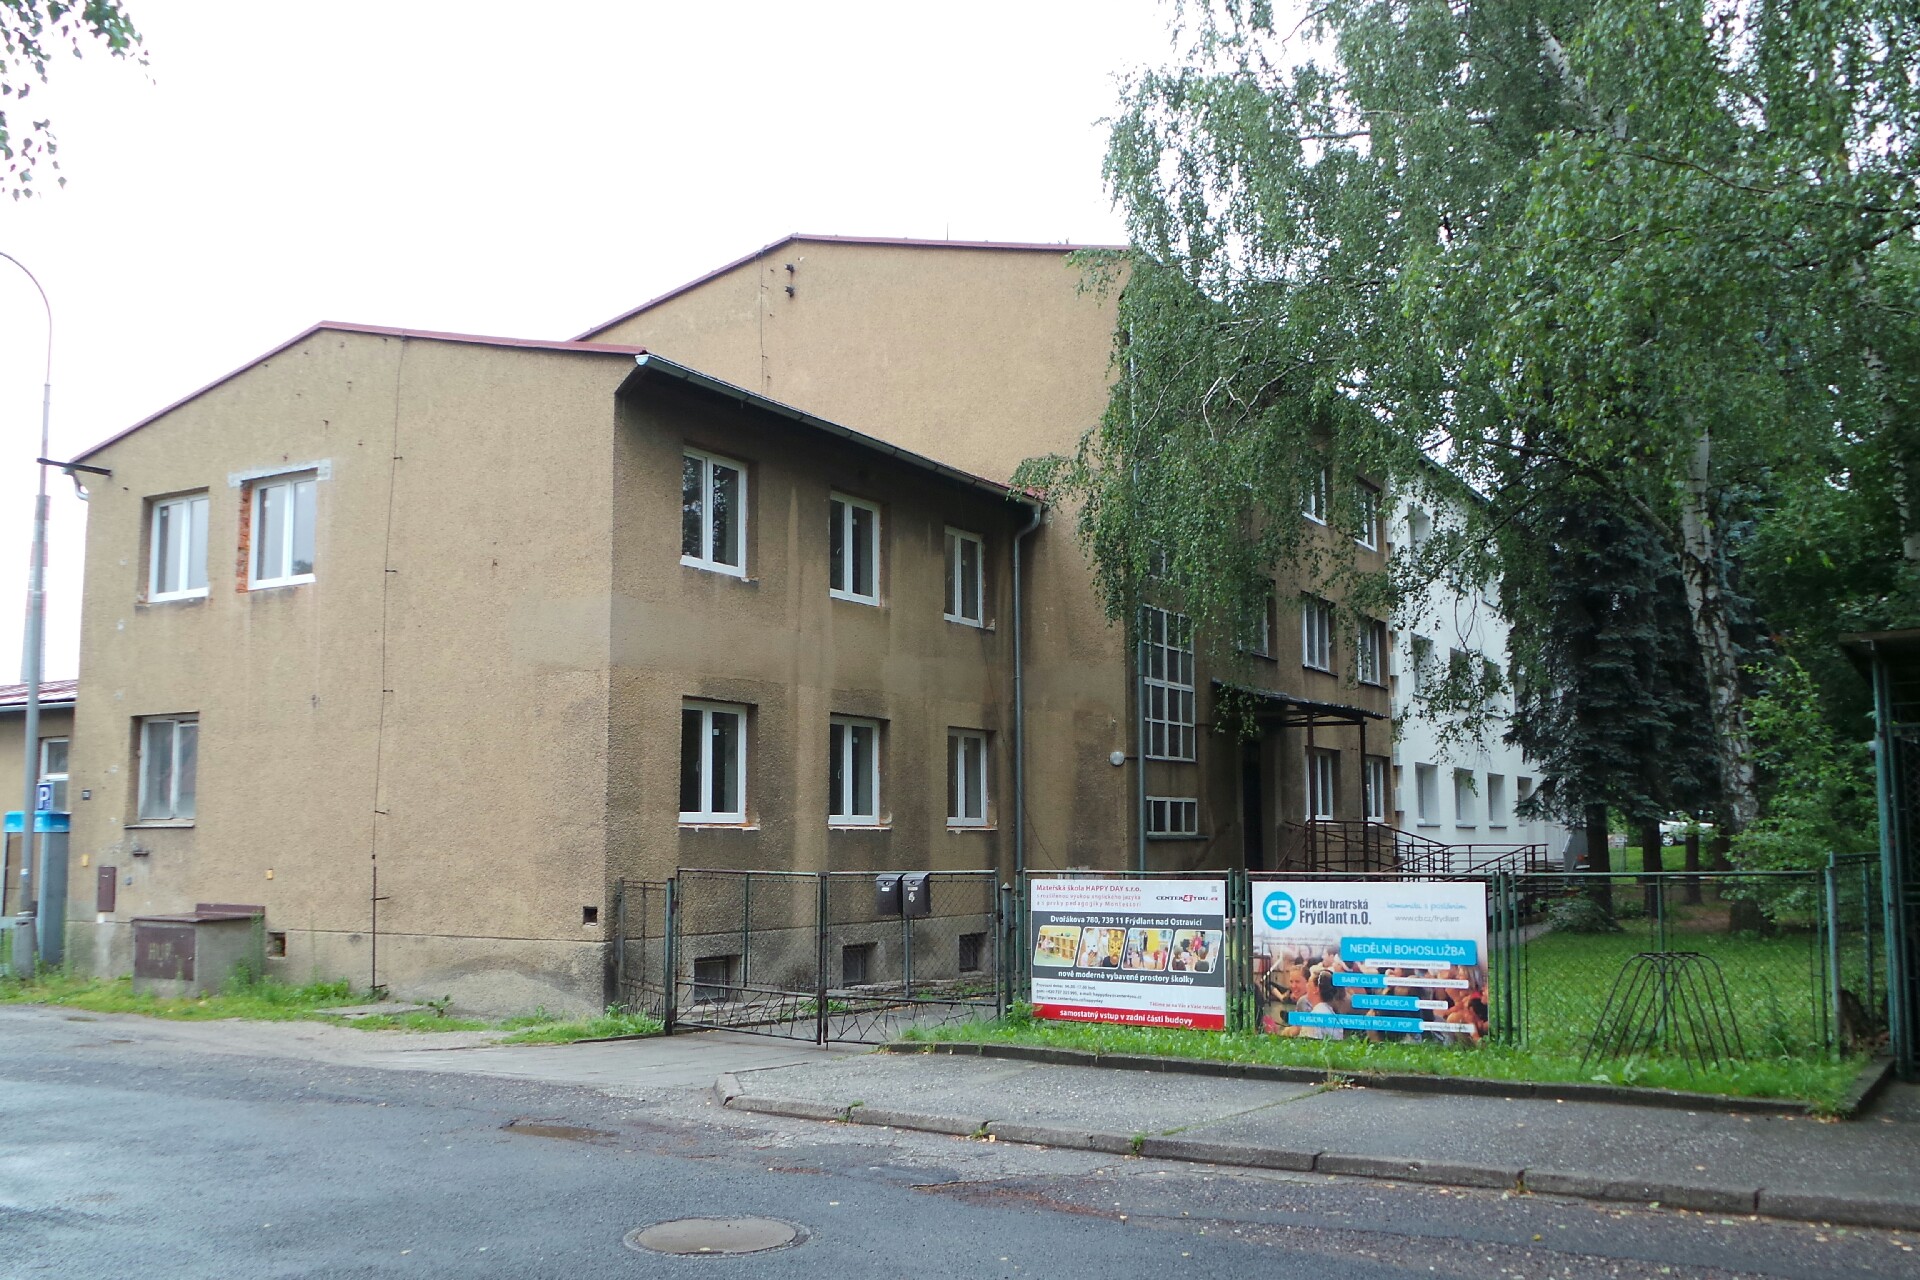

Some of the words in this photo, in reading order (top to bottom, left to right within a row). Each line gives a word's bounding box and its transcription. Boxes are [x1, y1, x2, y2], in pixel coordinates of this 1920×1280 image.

[39, 786, 50, 808] P
[1300, 898, 1328, 909] Církev
[1330, 899, 1368, 909] bratrská
[1125, 917, 1154, 926] Frýdlant
[1300, 910, 1347, 925] Frýdlant
[1350, 912, 1372, 925] n.O.
[1350, 942, 1392, 954] NEDĚLNÍ
[1394, 944, 1465, 956] BOHOSLUŽBA
[1140, 975, 1169, 983] prostory
[1170, 975, 1194, 984] školky
[1060, 1010, 1098, 1019] samostatný
[1147, 1014, 1163, 1022] části
[1165, 1016, 1192, 1025] budovy
